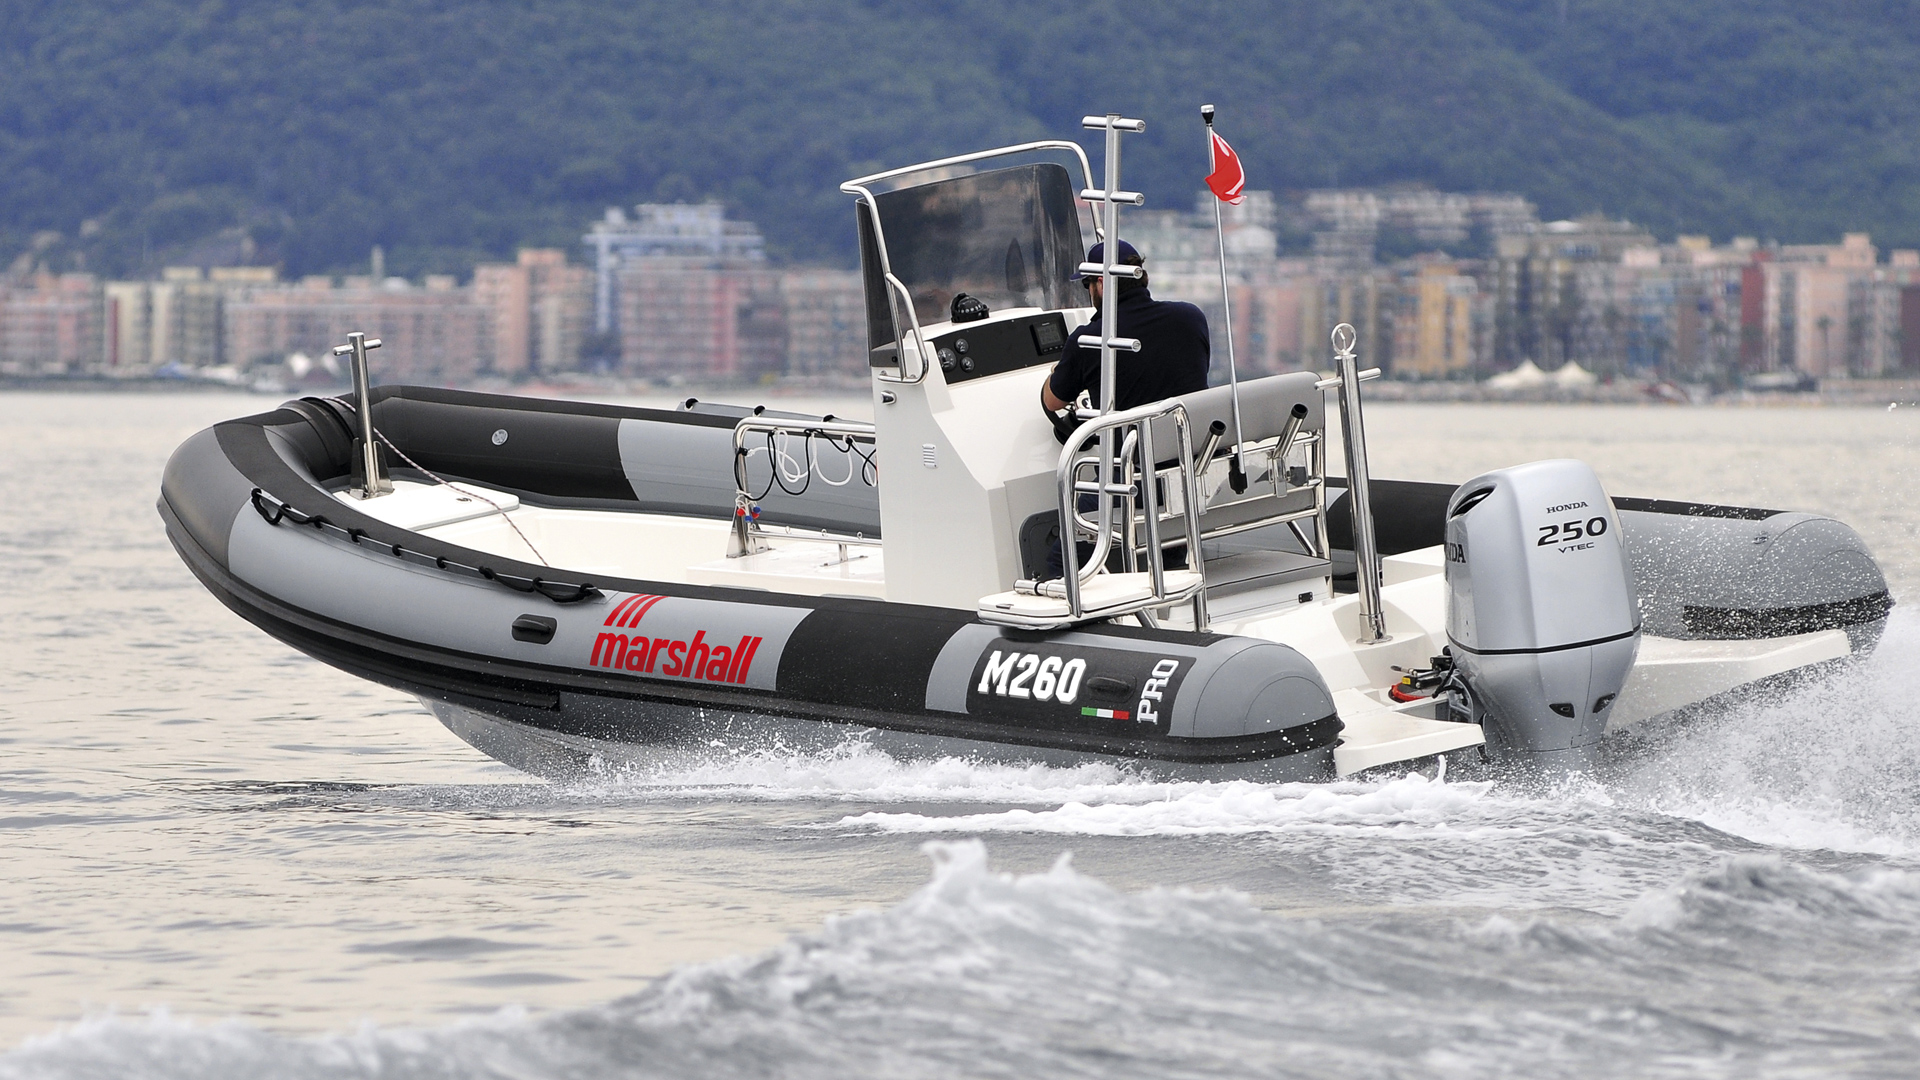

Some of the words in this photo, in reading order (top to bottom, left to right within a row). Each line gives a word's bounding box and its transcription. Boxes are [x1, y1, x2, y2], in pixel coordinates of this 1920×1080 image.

[1546, 501, 1589, 514] HONDA
[1537, 516, 1608, 546] 250
[1557, 541, 1595, 554] VTEC
[589, 629, 763, 685] marshall
[977, 650, 1087, 705] M260
[1136, 658, 1180, 725] PRO
